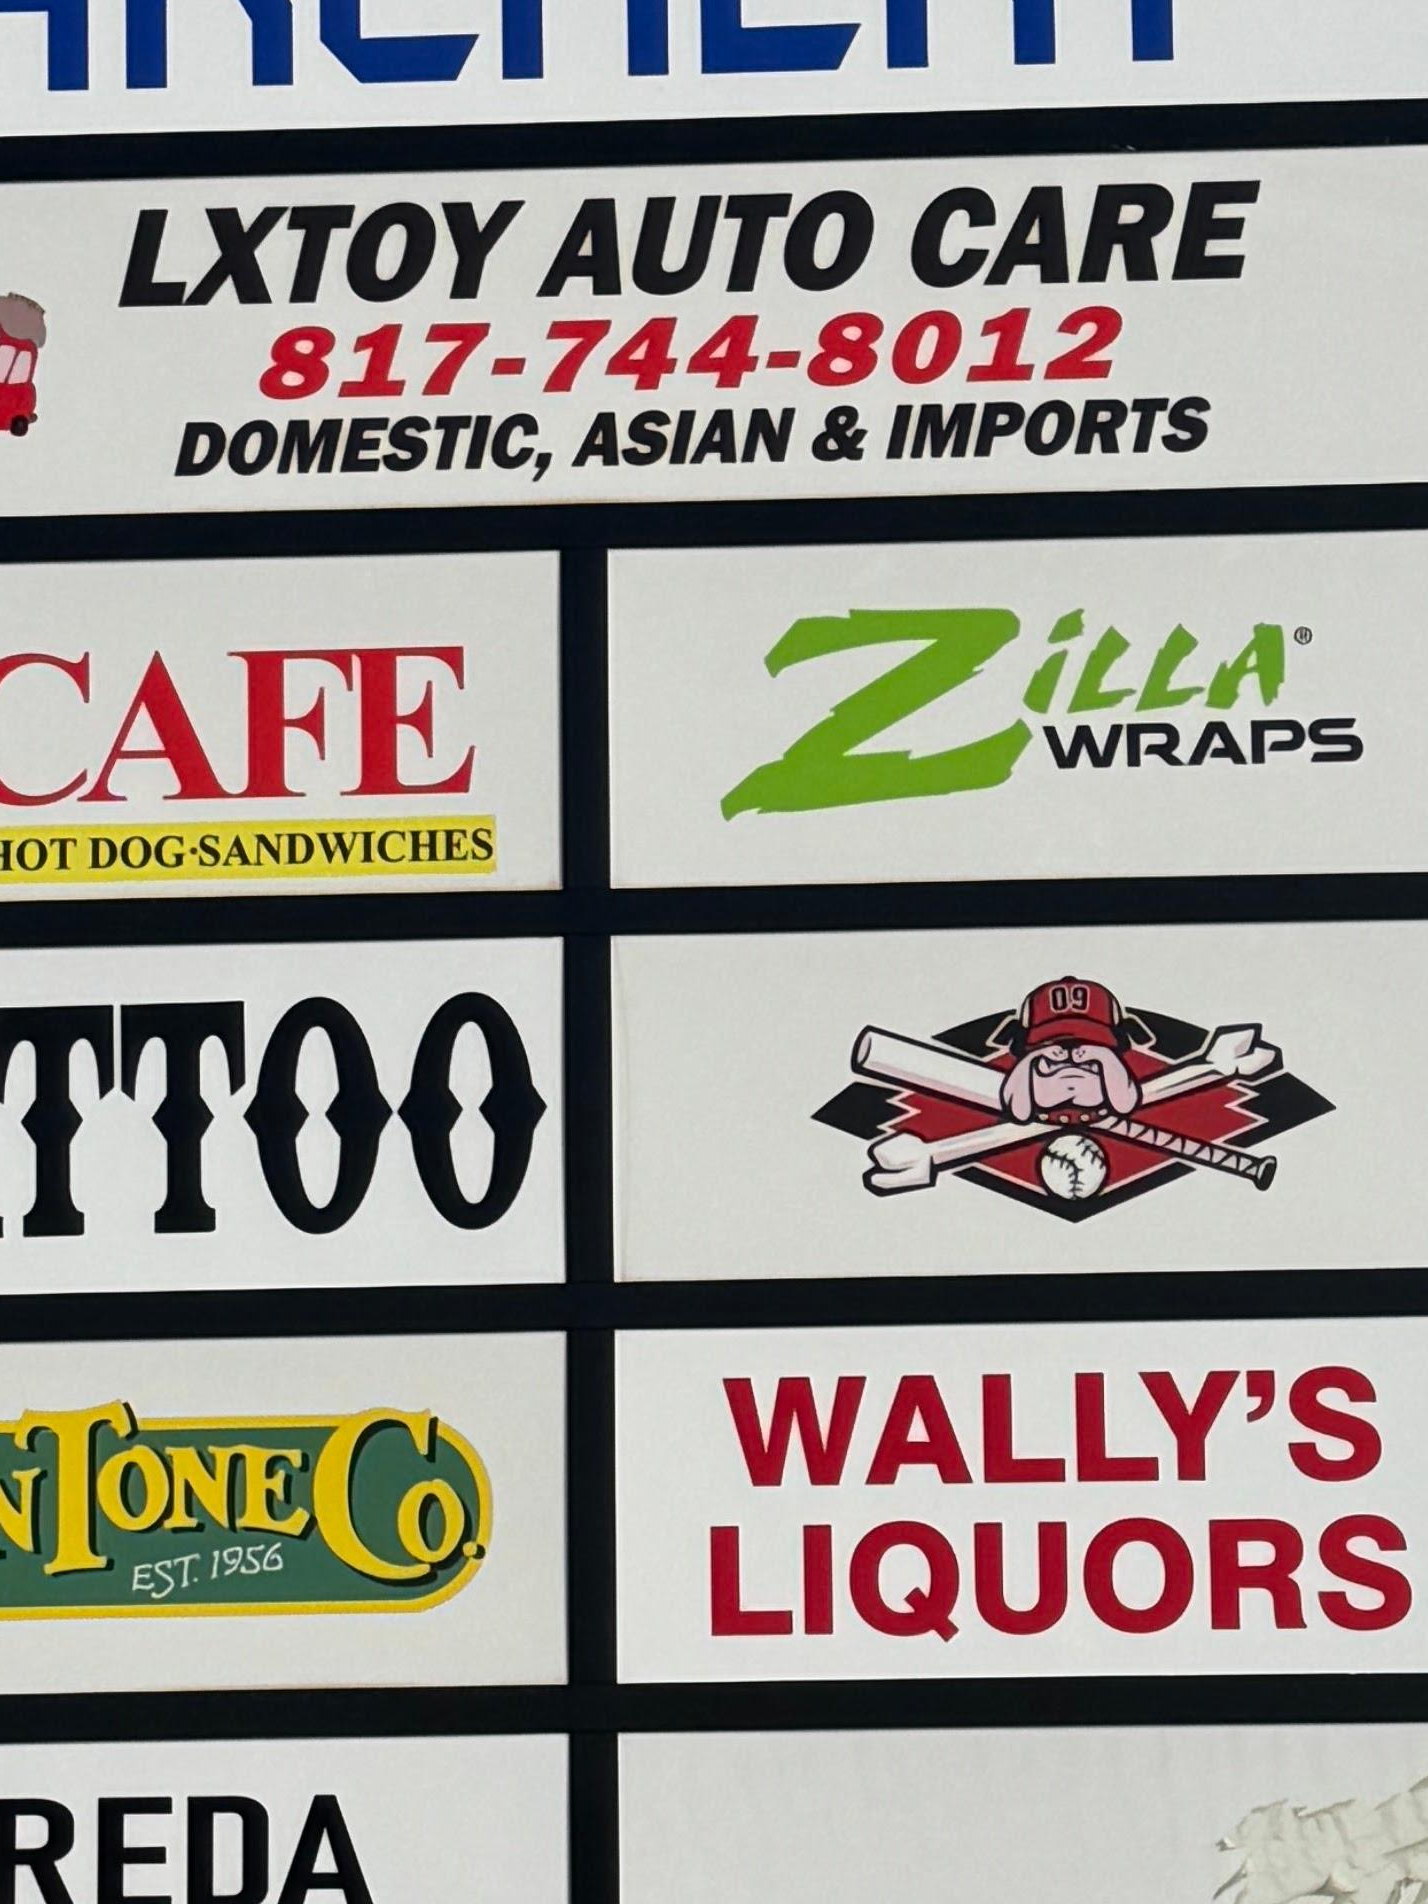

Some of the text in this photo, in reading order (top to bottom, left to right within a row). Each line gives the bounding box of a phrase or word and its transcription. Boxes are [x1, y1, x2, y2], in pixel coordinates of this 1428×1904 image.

[118, 180, 1261, 307] LXTOY AUTO CARE
[259, 305, 1123, 400] 817-744-8012
[173, 396, 1211, 482] DOMESTIC, ASIAN & IMPORTS
[1042, 718, 1365, 770] WRAPS
[1049, 984, 1090, 1013] 09
[724, 1367, 1381, 1487] WALLY'S
[131, 1542, 284, 1600] EST. 1956
[711, 1515, 1411, 1642] LIQUORS
